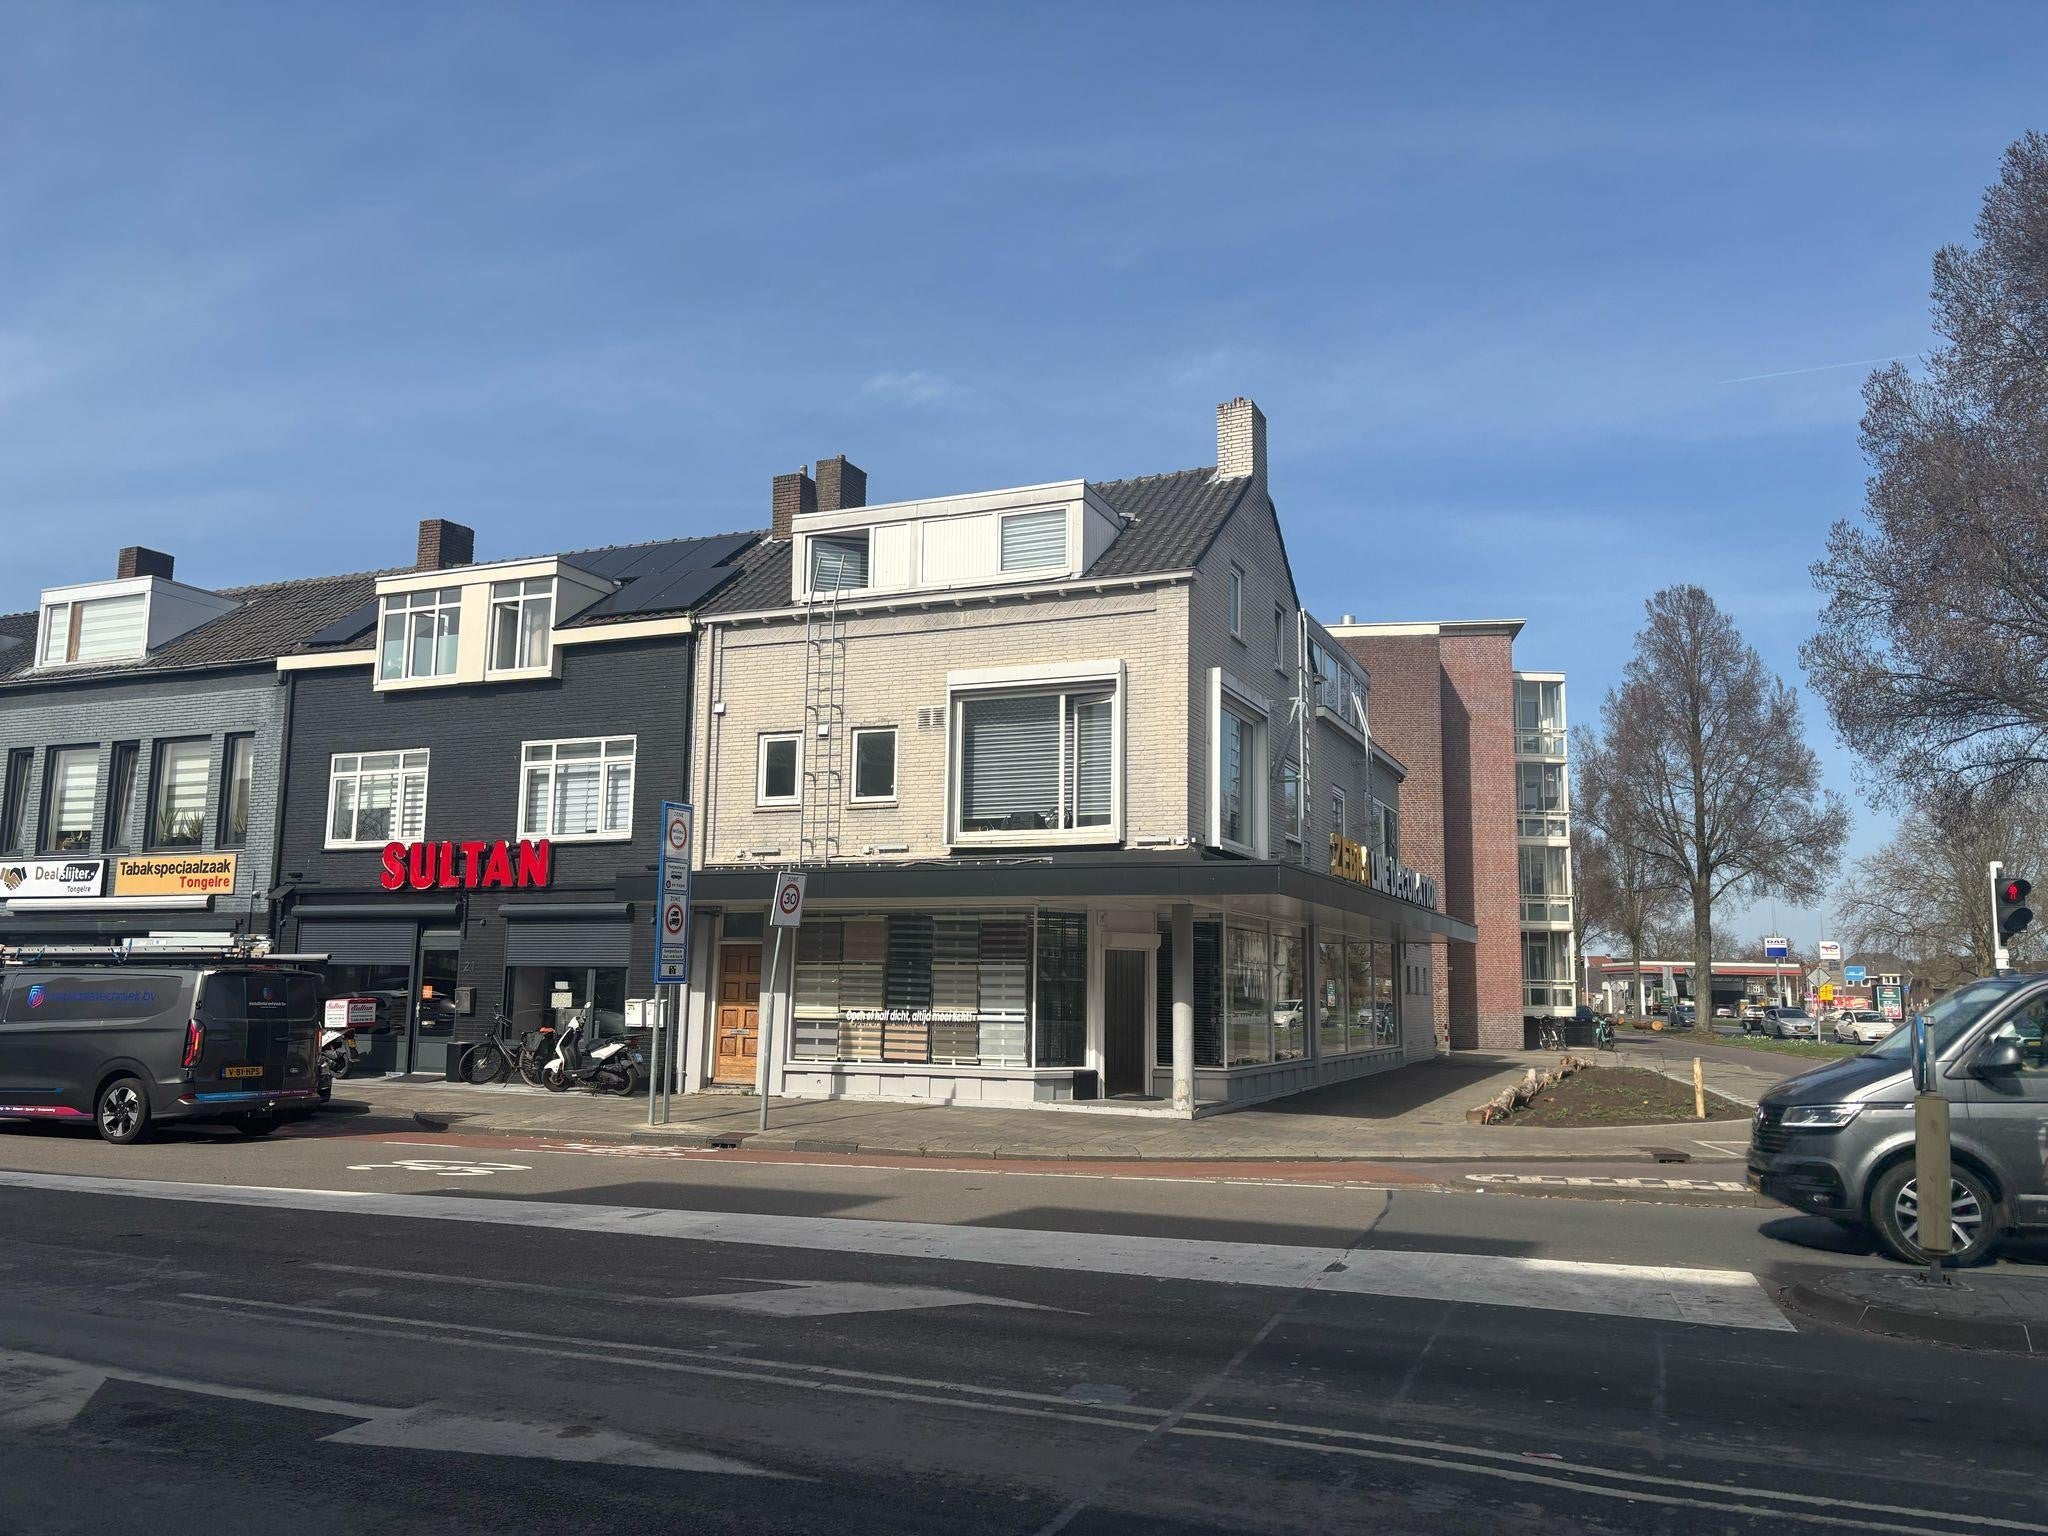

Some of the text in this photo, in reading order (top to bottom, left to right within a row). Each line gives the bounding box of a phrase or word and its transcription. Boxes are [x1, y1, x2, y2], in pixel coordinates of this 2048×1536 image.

[120, 859, 231, 878] Tabakspeciaalzaak
[380, 839, 549, 890] SULTAN
[1330, 833, 1371, 889] ZEBRA
[67, 885, 91, 893] Tongelre
[180, 876, 230, 891] Tongelre
[784, 893, 796, 904] 30
